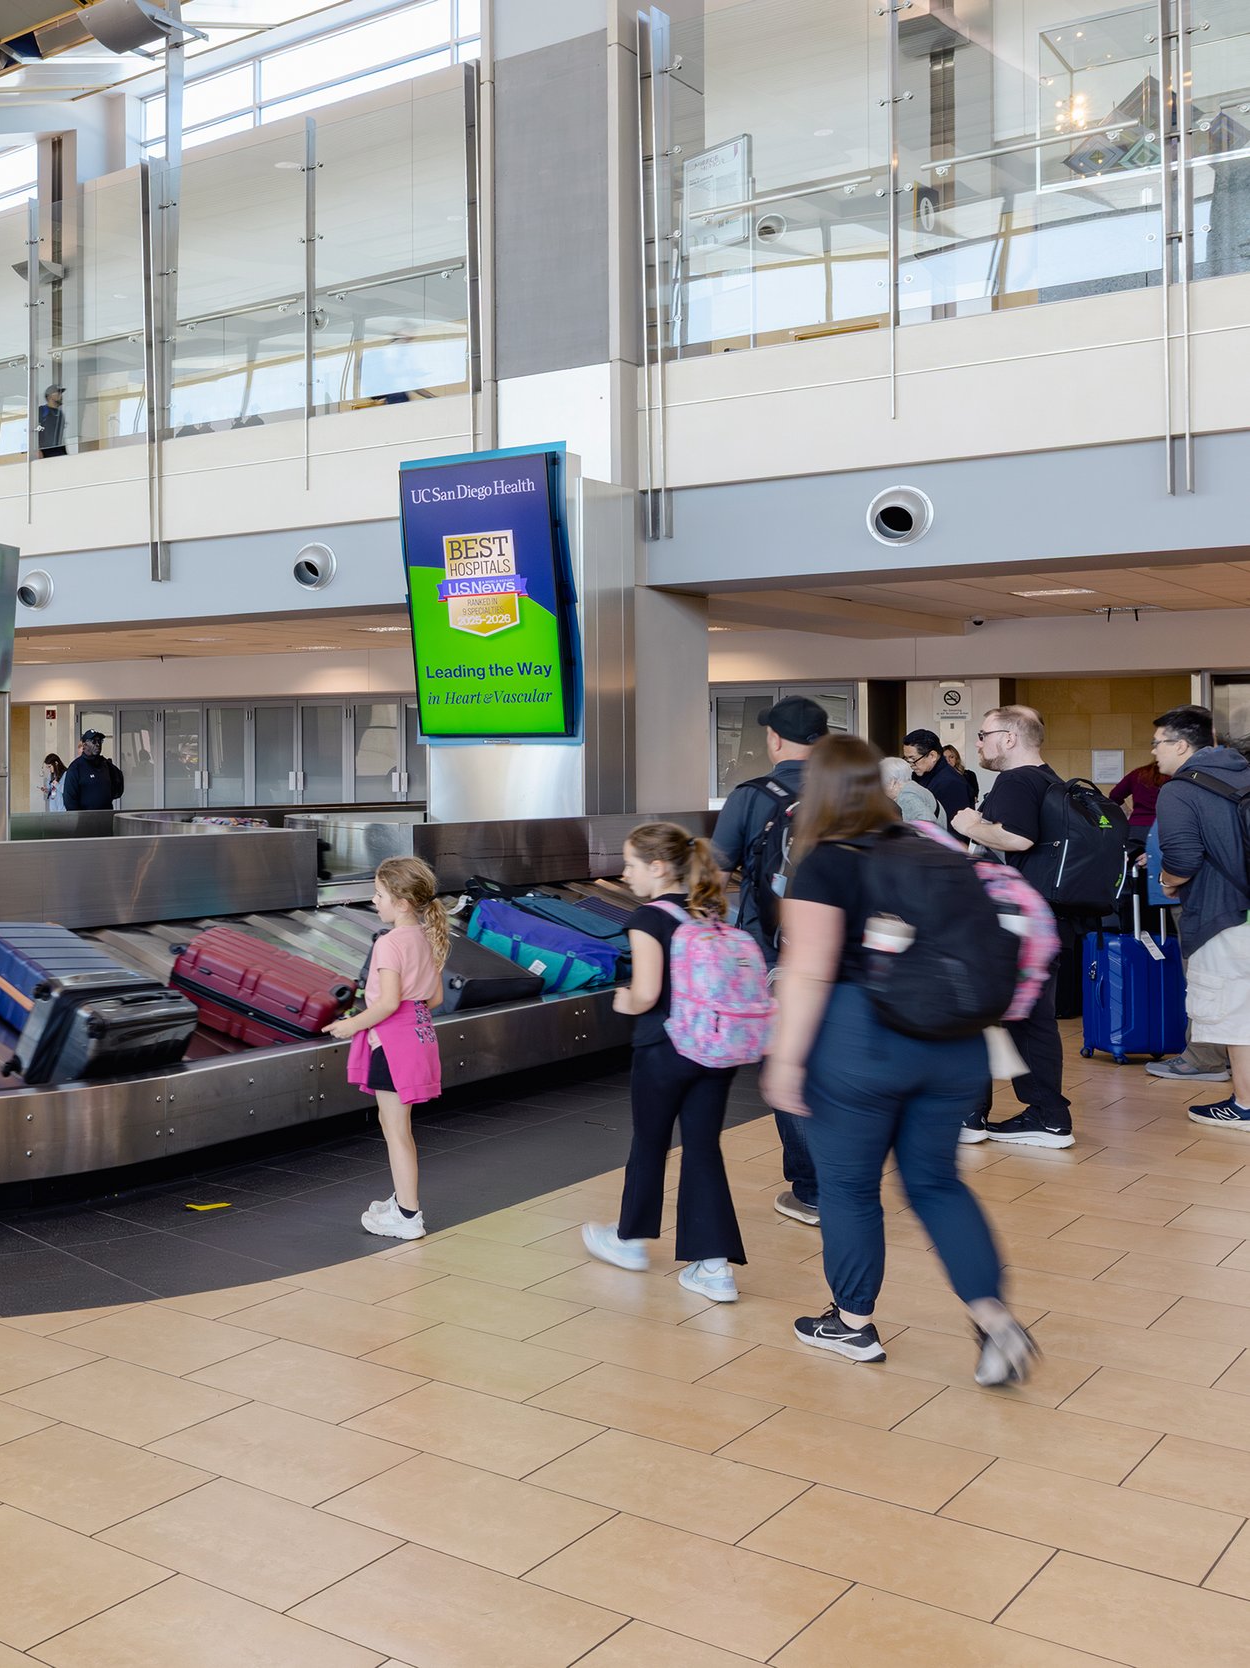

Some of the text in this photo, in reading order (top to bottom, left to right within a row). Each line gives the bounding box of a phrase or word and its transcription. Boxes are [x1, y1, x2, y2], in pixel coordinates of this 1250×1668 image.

[411, 478, 536, 504] UC San Diego Health
[448, 536, 508, 560] BEST
[450, 559, 511, 577] HOSPITALS
[467, 597, 498, 606] RANKED IN
[467, 606, 505, 615] SPECIALTIES
[425, 662, 552, 680] Leading the Way
[428, 688, 553, 704] in Heart & Vascular
